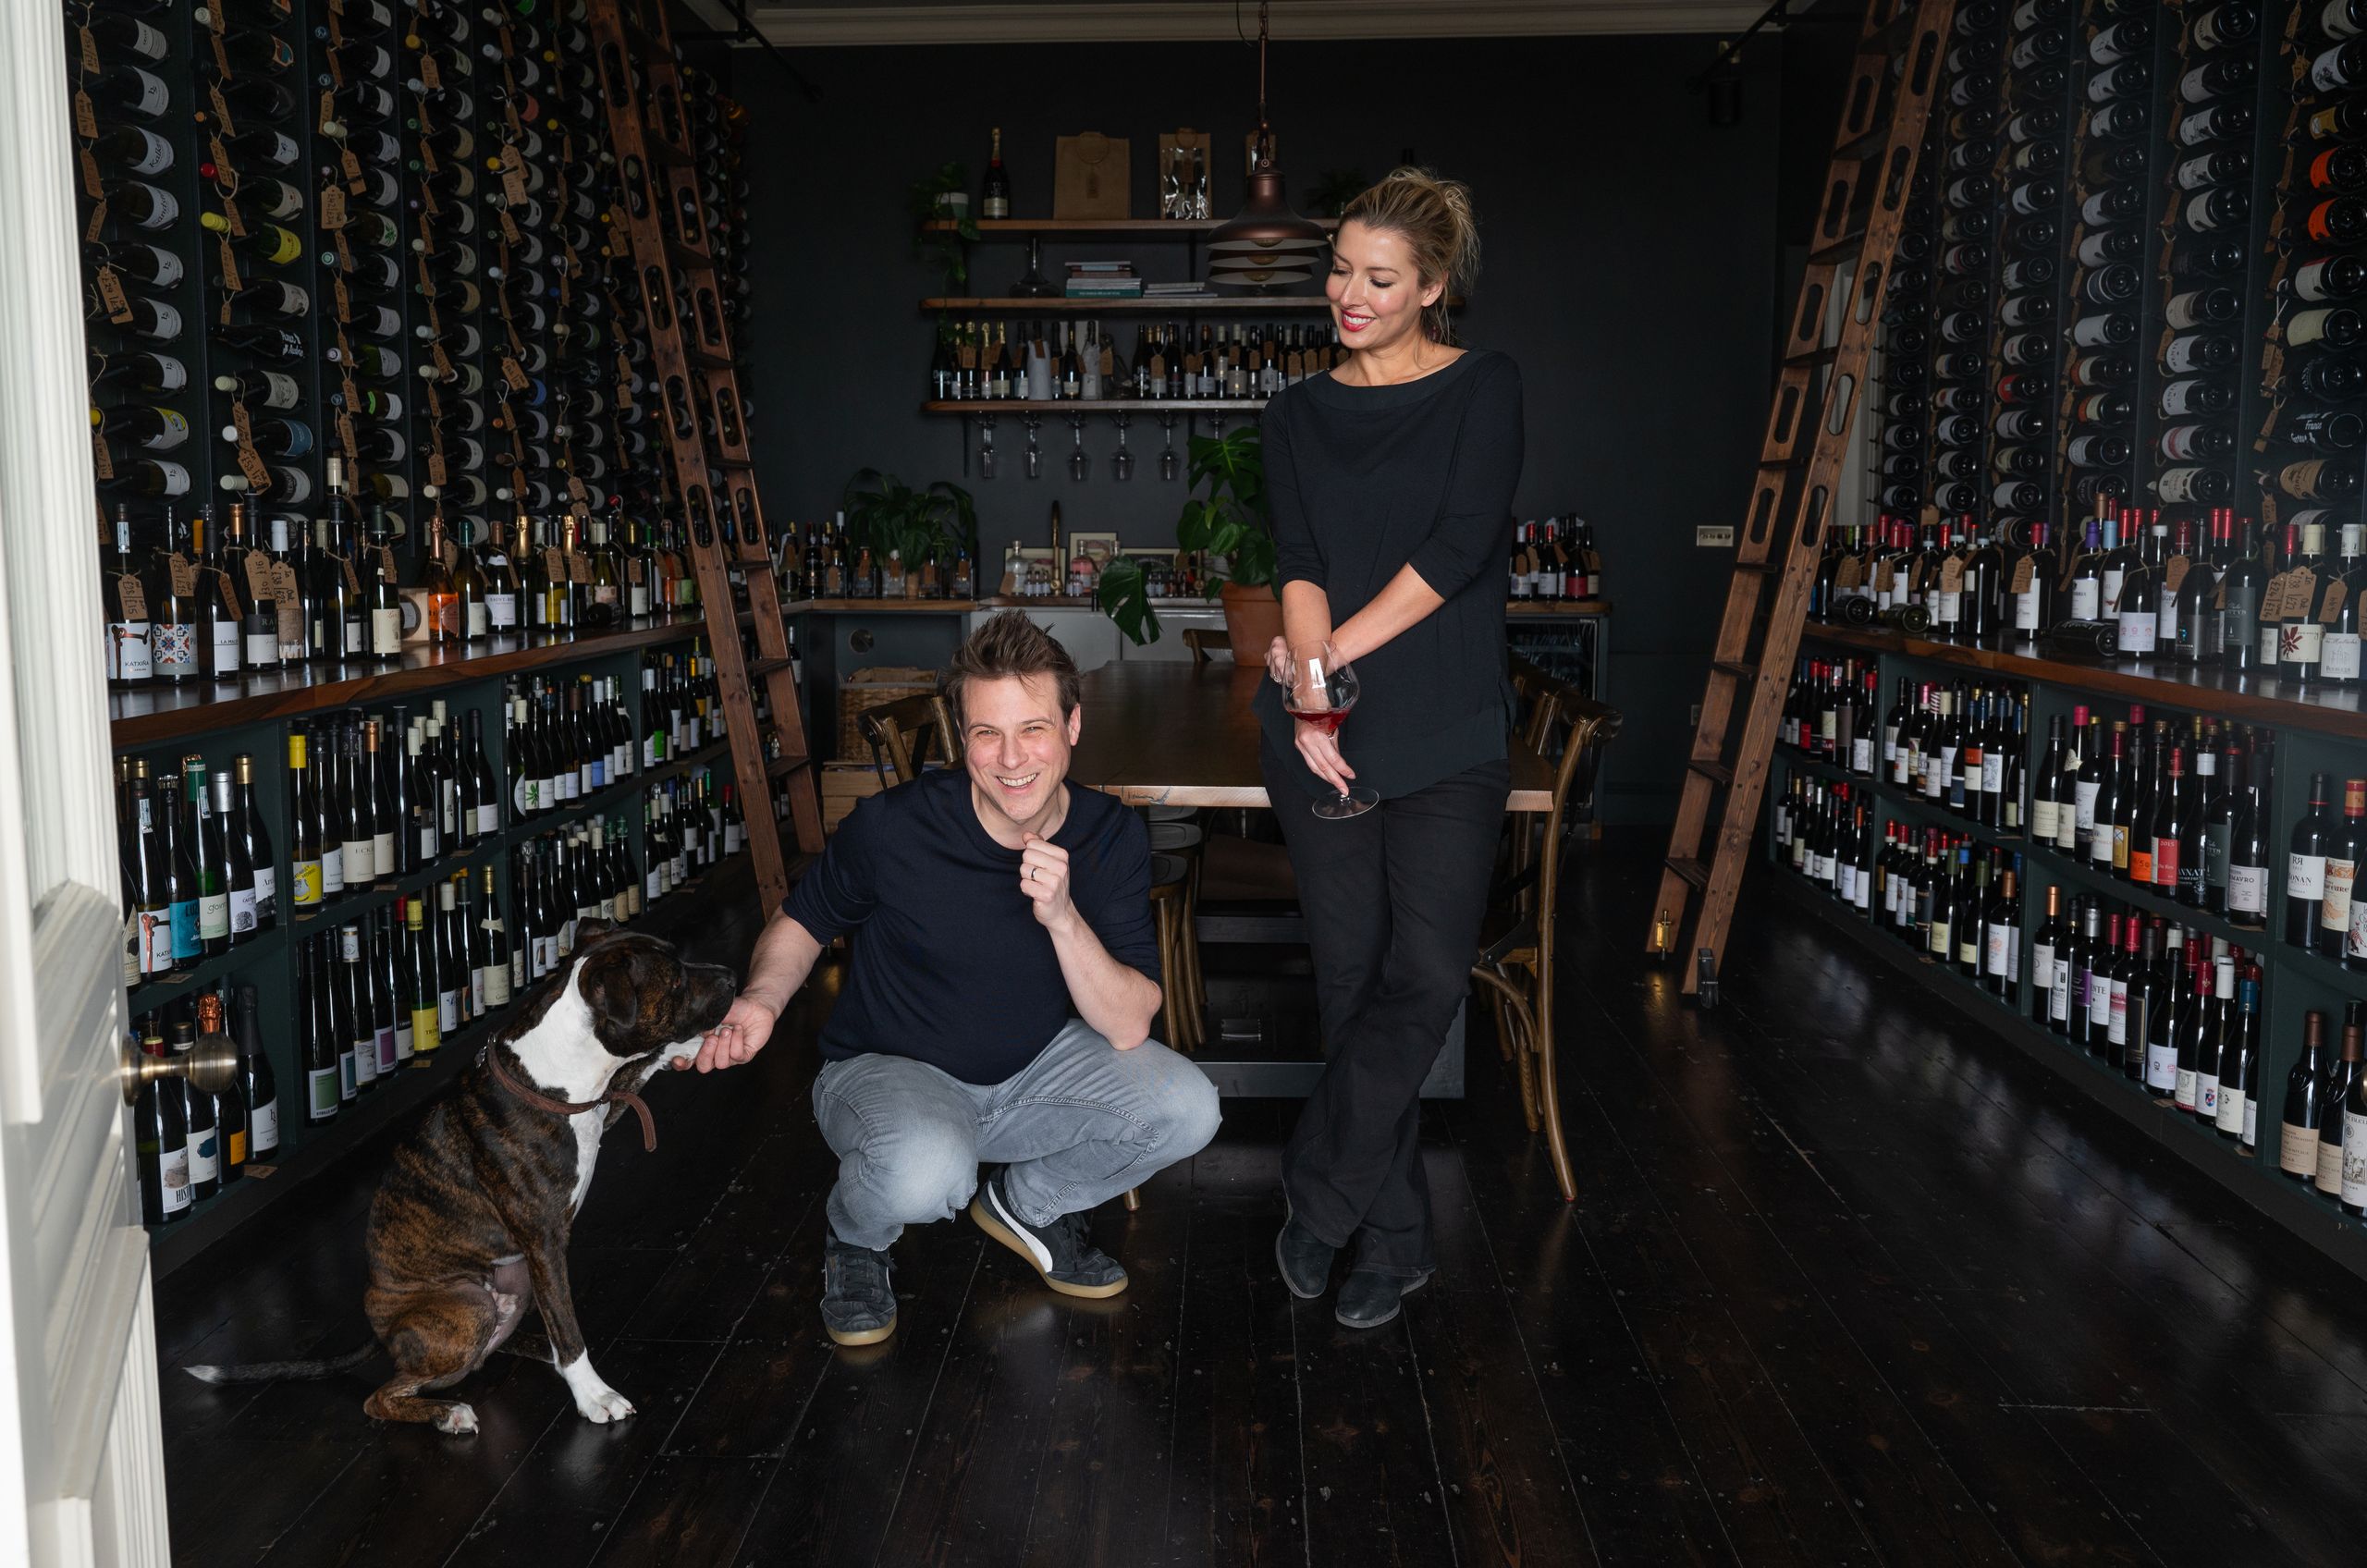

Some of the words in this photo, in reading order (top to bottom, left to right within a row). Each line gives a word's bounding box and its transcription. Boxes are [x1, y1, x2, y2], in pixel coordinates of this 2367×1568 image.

[284, 570, 292, 578] In
[2305, 576, 2313, 584] In
[2288, 575, 2302, 588] £38
[123, 582, 135, 595] £28
[287, 589, 295, 601] Out
[2267, 581, 2281, 596] £24
[125, 600, 138, 614] £15
[2300, 597, 2309, 609] Out
[2263, 603, 2275, 618] £14
